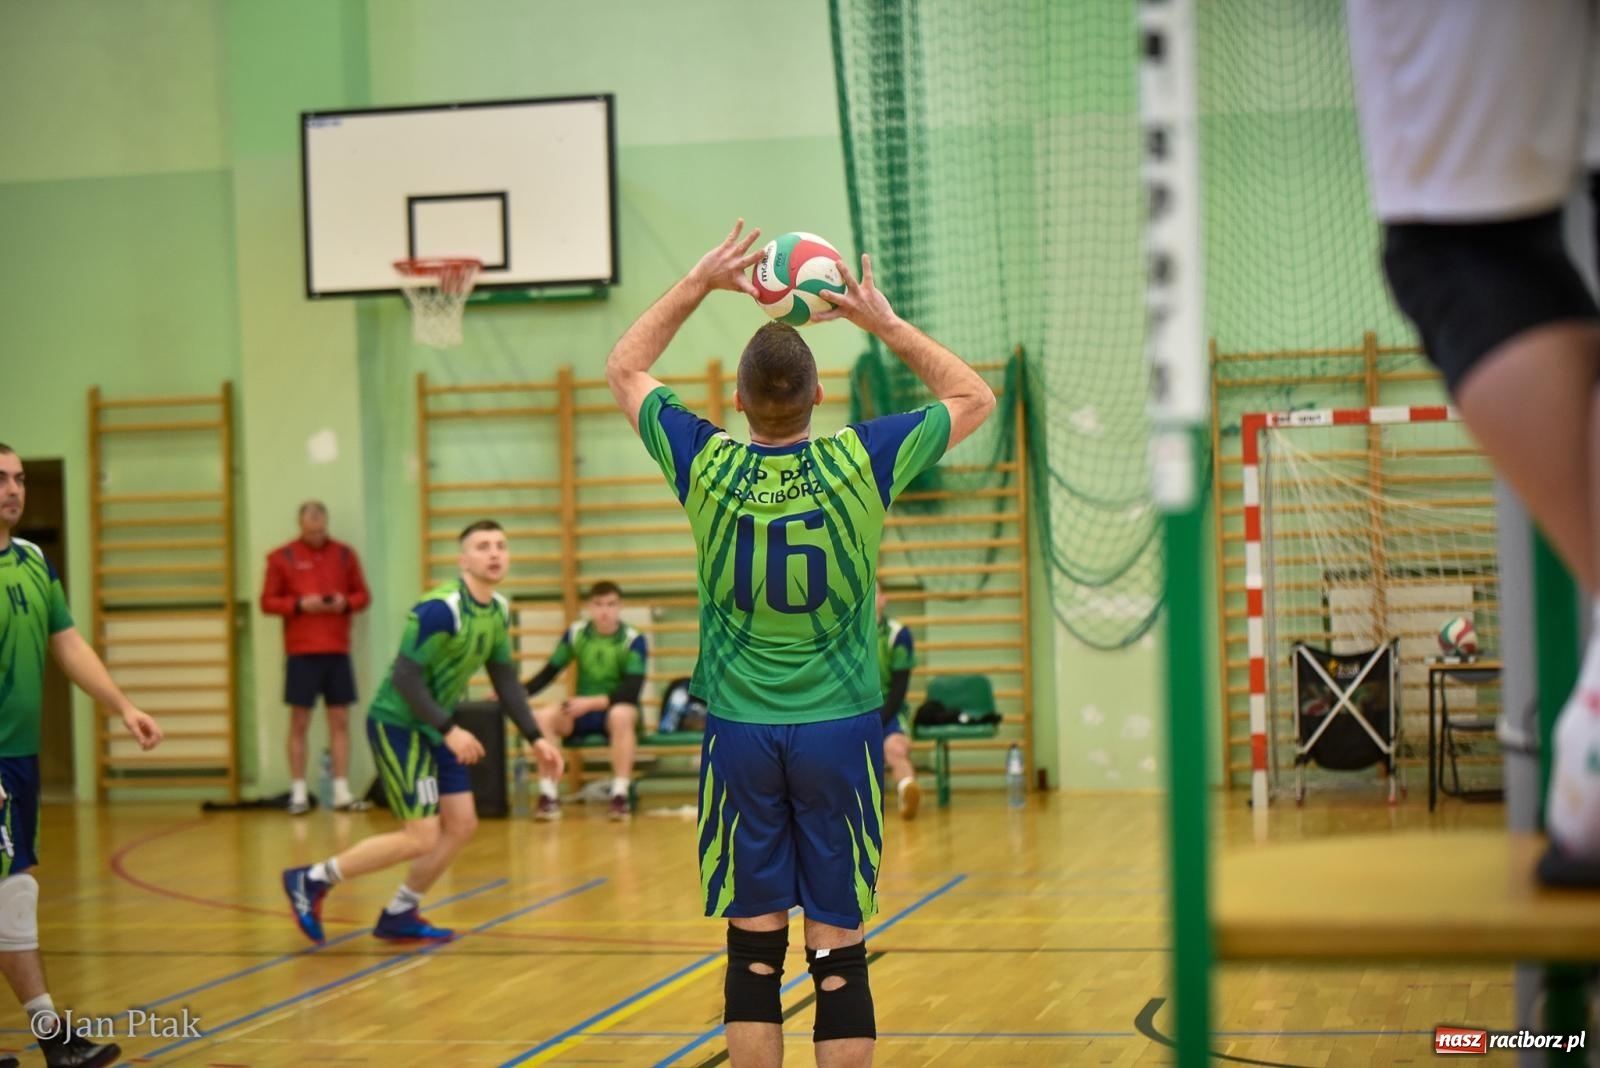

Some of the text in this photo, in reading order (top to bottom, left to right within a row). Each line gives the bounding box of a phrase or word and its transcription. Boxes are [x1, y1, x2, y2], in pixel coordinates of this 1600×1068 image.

[738, 467, 768, 485] KP
[732, 480, 824, 504] RACIBÓRZ
[734, 509, 828, 614] 16
[6, 583, 29, 615] 14
[417, 776, 439, 806] 10
